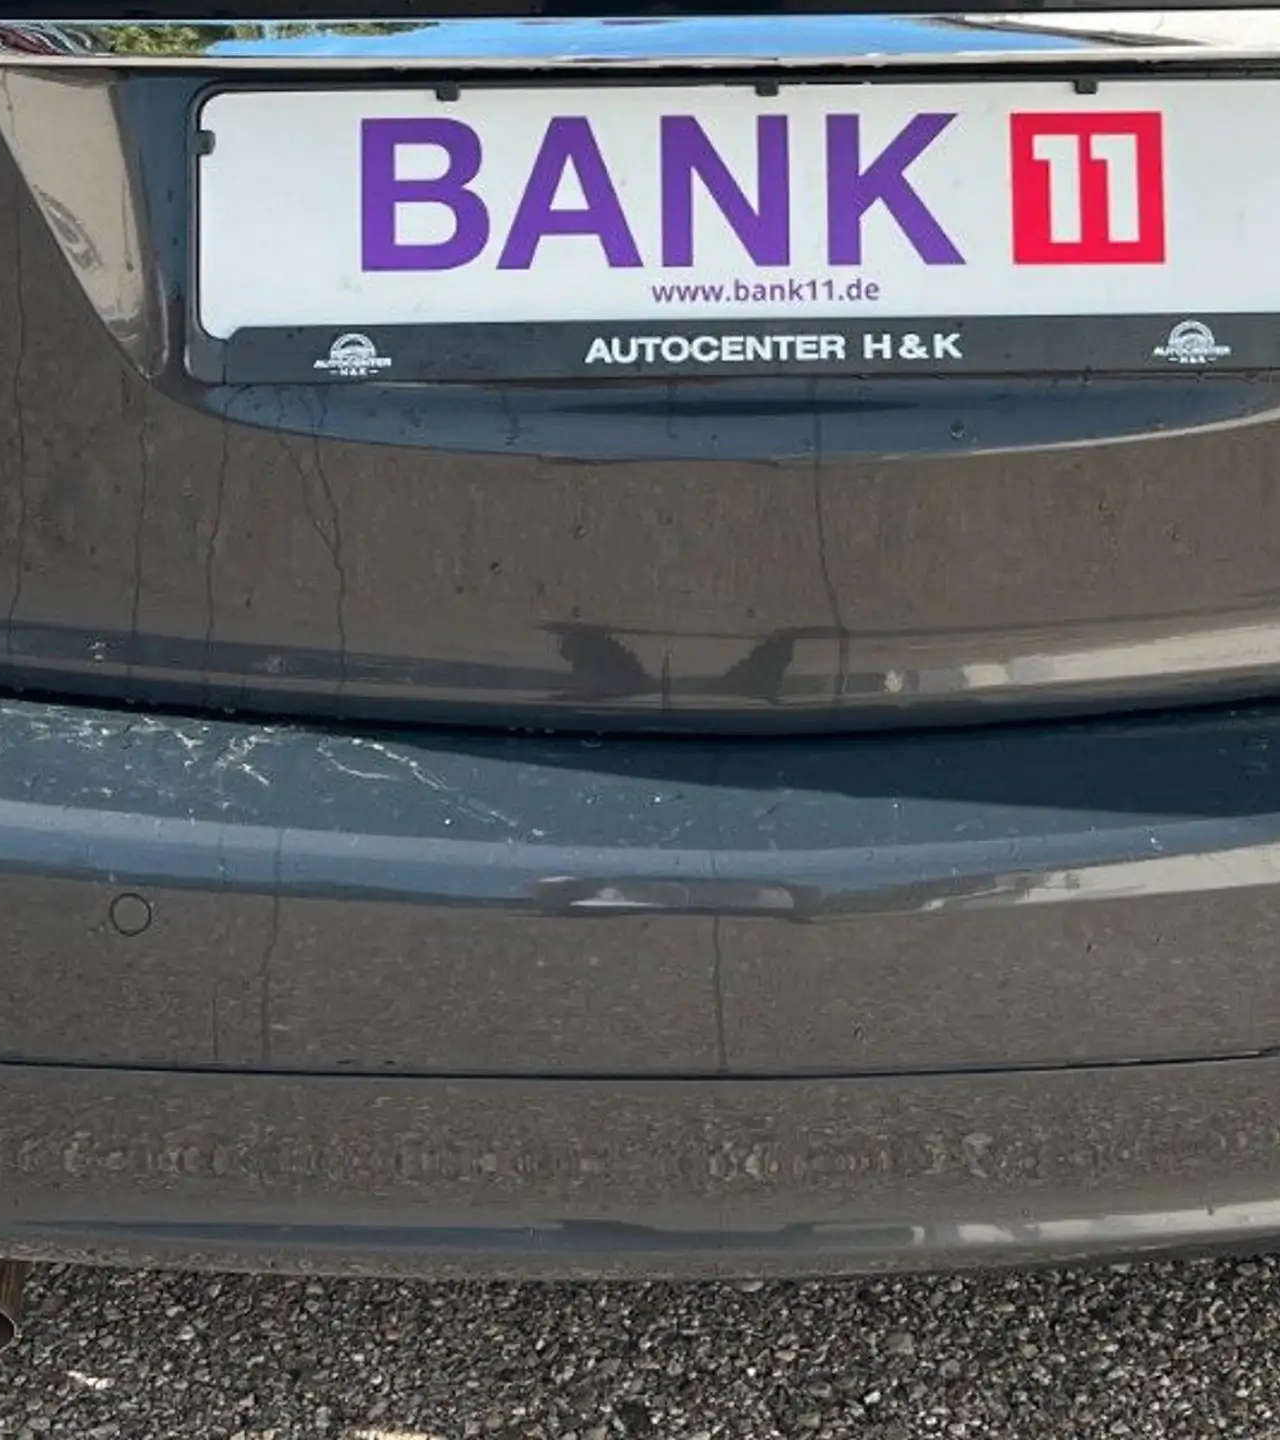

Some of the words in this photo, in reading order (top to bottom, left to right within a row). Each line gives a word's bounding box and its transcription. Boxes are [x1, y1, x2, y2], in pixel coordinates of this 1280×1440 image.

[361, 113, 965, 272] BANK
[1031, 133, 1140, 244] 11
[651, 278, 880, 303] www.bank11.de
[584, 334, 847, 364] AUTOCENTER
